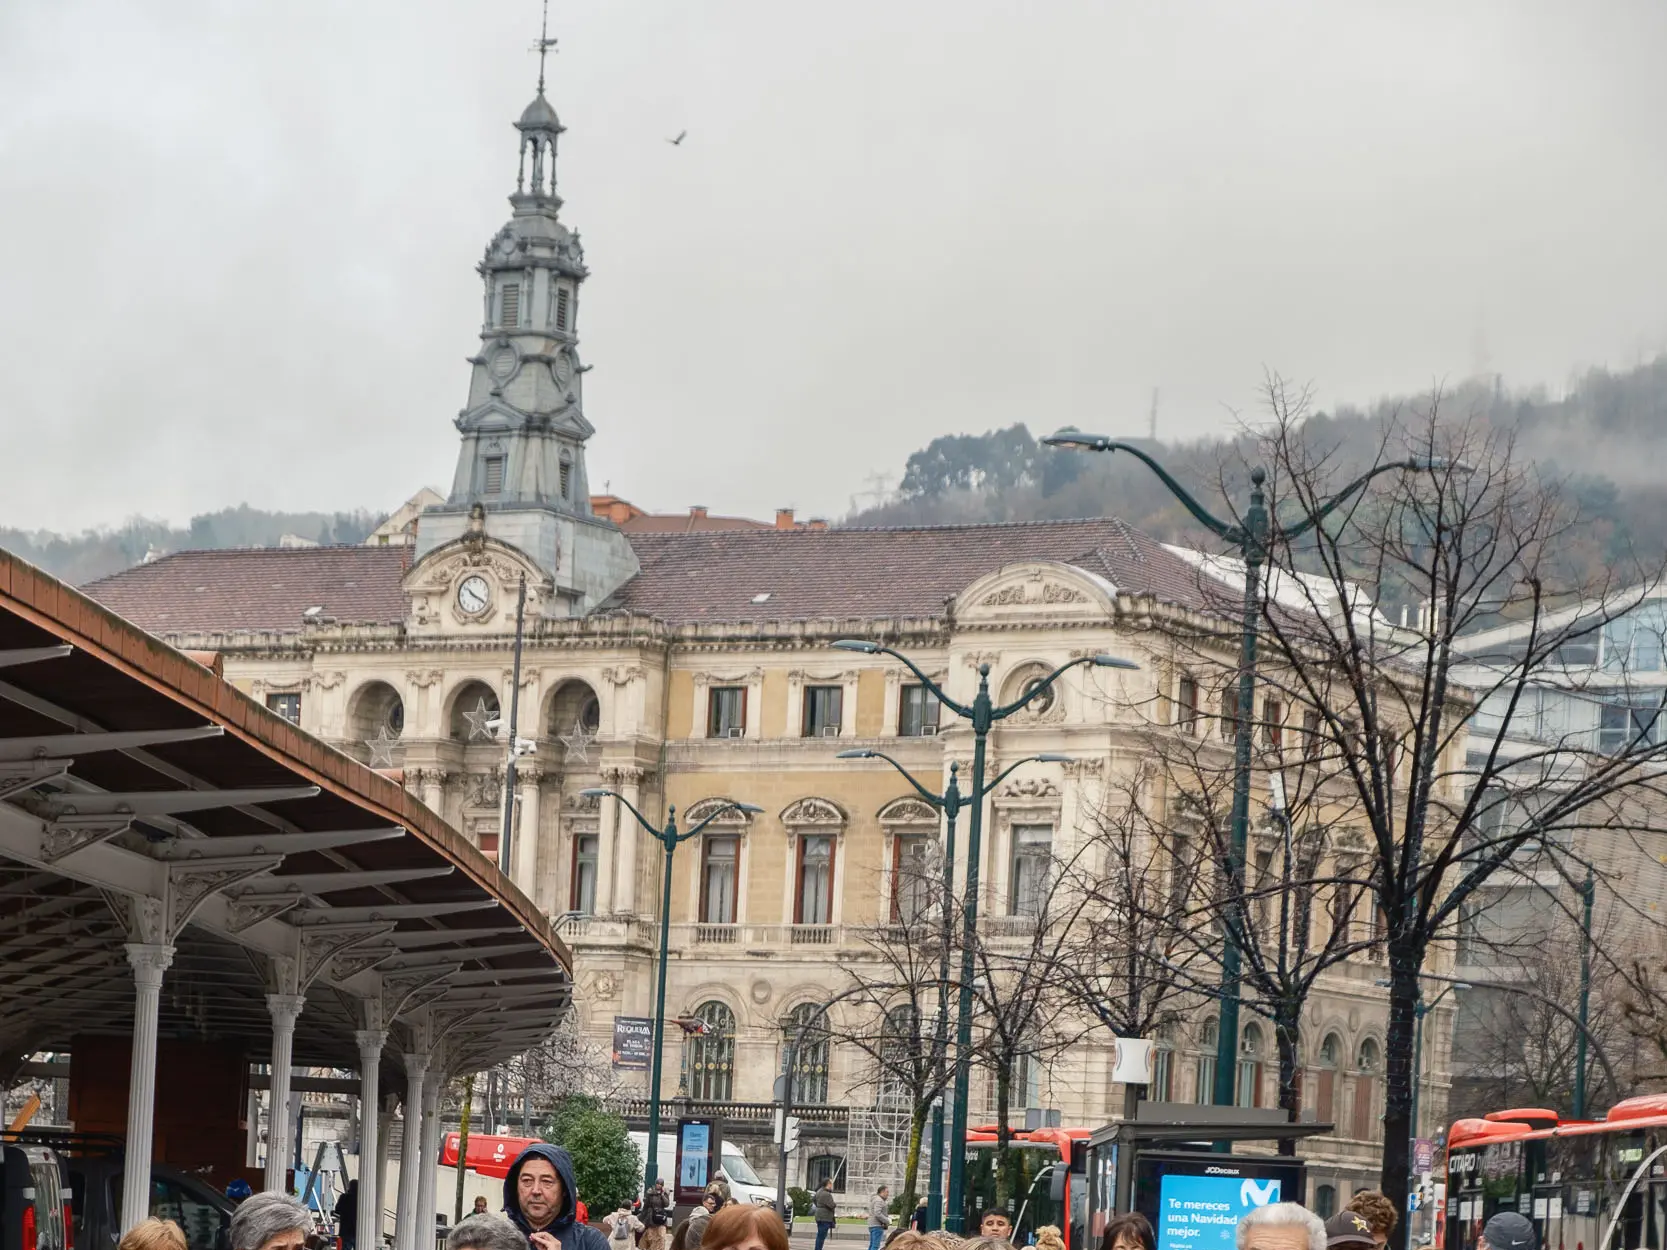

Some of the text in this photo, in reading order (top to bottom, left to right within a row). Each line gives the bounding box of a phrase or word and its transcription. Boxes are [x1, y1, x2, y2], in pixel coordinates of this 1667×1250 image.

[617, 1024, 651, 1034] REQUIEM
[1449, 1153, 1476, 1173] CITARO
[1204, 1166, 1240, 1175] JCDecaux
[1168, 1198, 1230, 1211] Te mereces
[1167, 1213, 1238, 1225] una Navidad
[1167, 1226, 1200, 1239] mejor.
